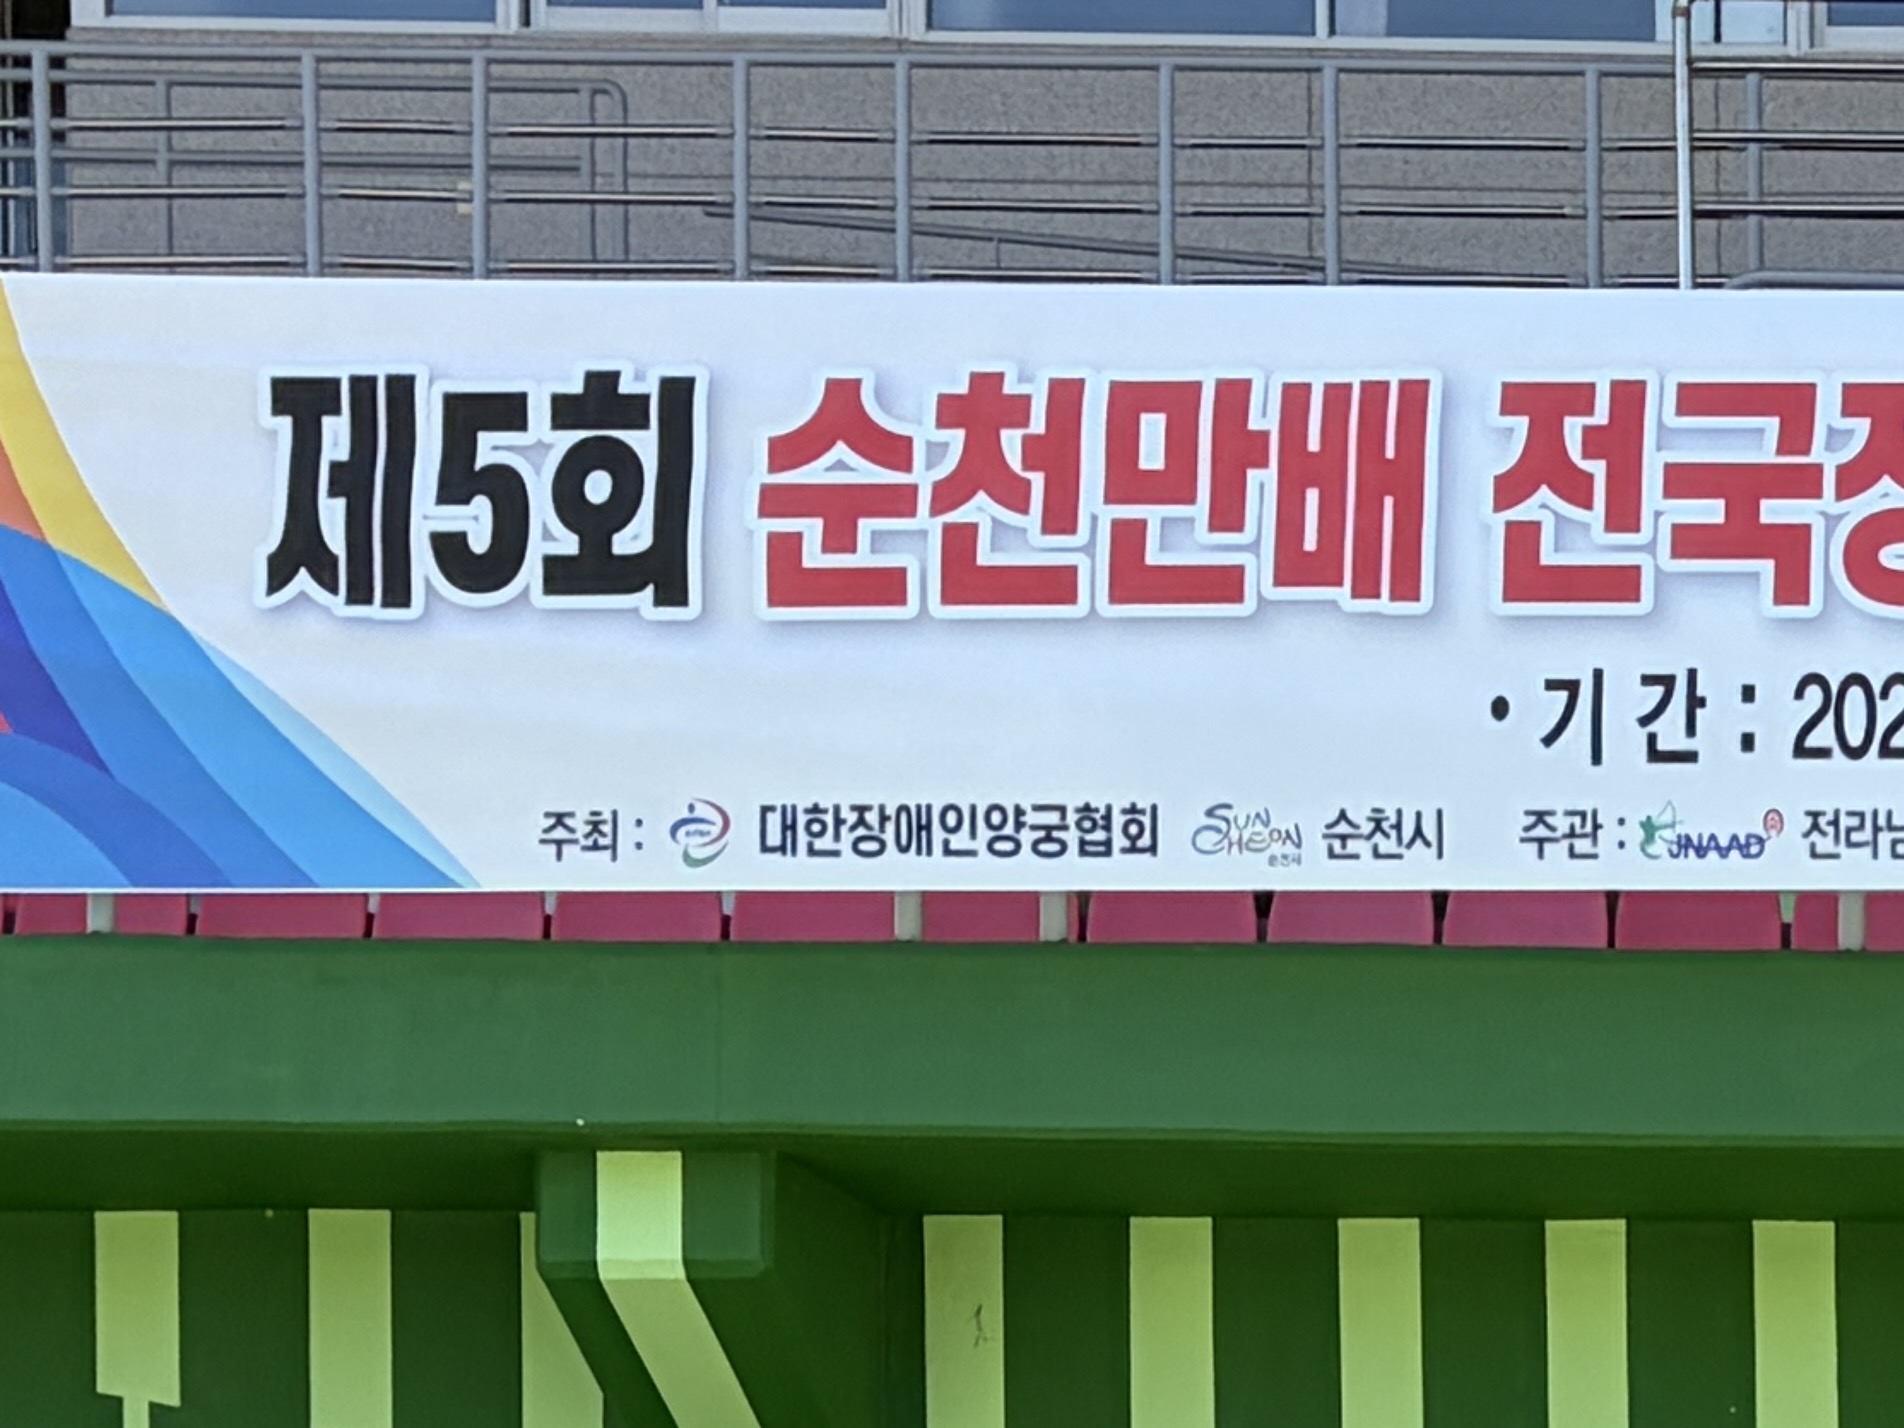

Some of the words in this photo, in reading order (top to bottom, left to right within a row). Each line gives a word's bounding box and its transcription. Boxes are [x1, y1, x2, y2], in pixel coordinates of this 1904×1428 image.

[265, 370, 697, 609] 제5회
[757, 371, 1431, 608] 순천만배
[538, 808, 619, 863] 주최
[759, 801, 1158, 859] 대한장애인양궁협회
[1322, 807, 1444, 860] 순천시
[1519, 808, 1604, 860] 주관
